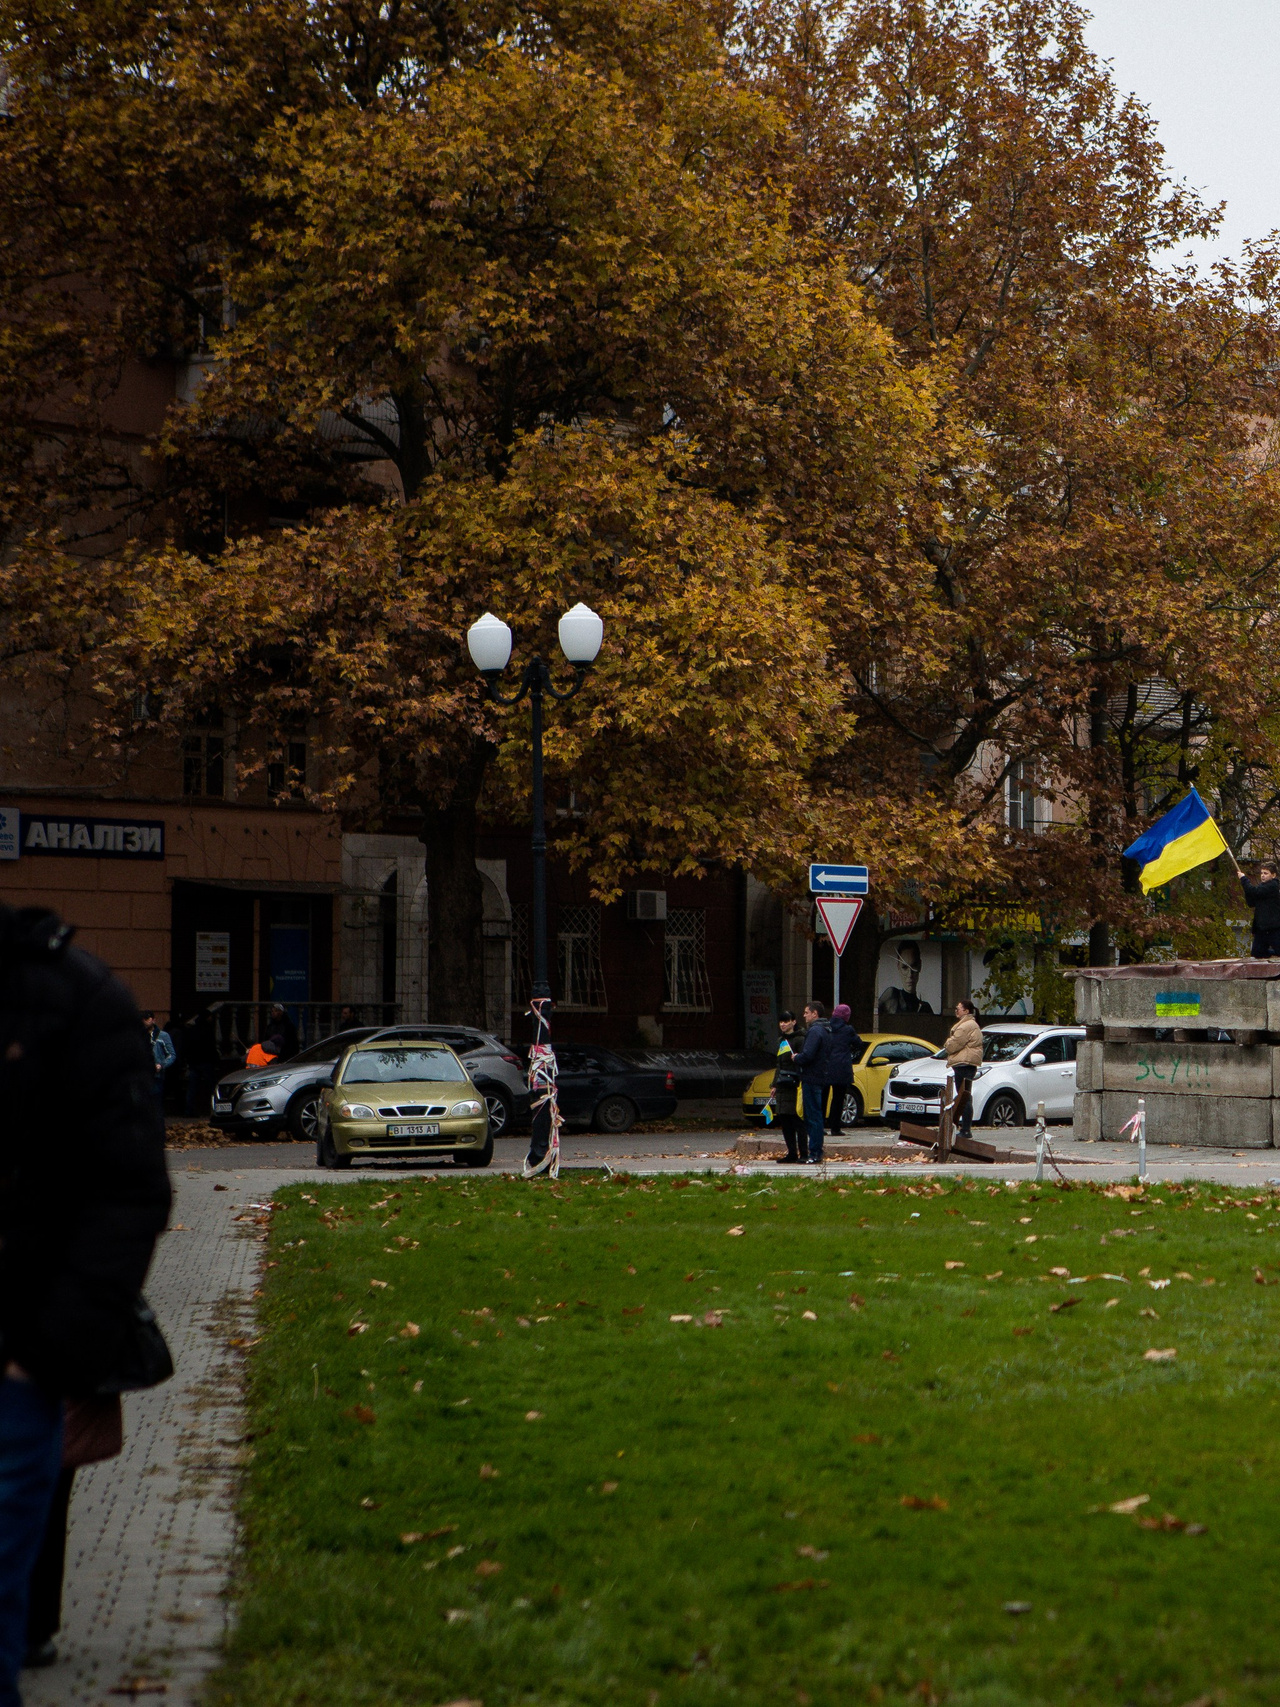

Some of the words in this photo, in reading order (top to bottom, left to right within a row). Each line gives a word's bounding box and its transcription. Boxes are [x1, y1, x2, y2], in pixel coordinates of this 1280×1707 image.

[24, 821, 162, 853] АНАЛІЗИ
[406, 1125, 424, 1134] 1313
[426, 1125, 437, 1133] AT
